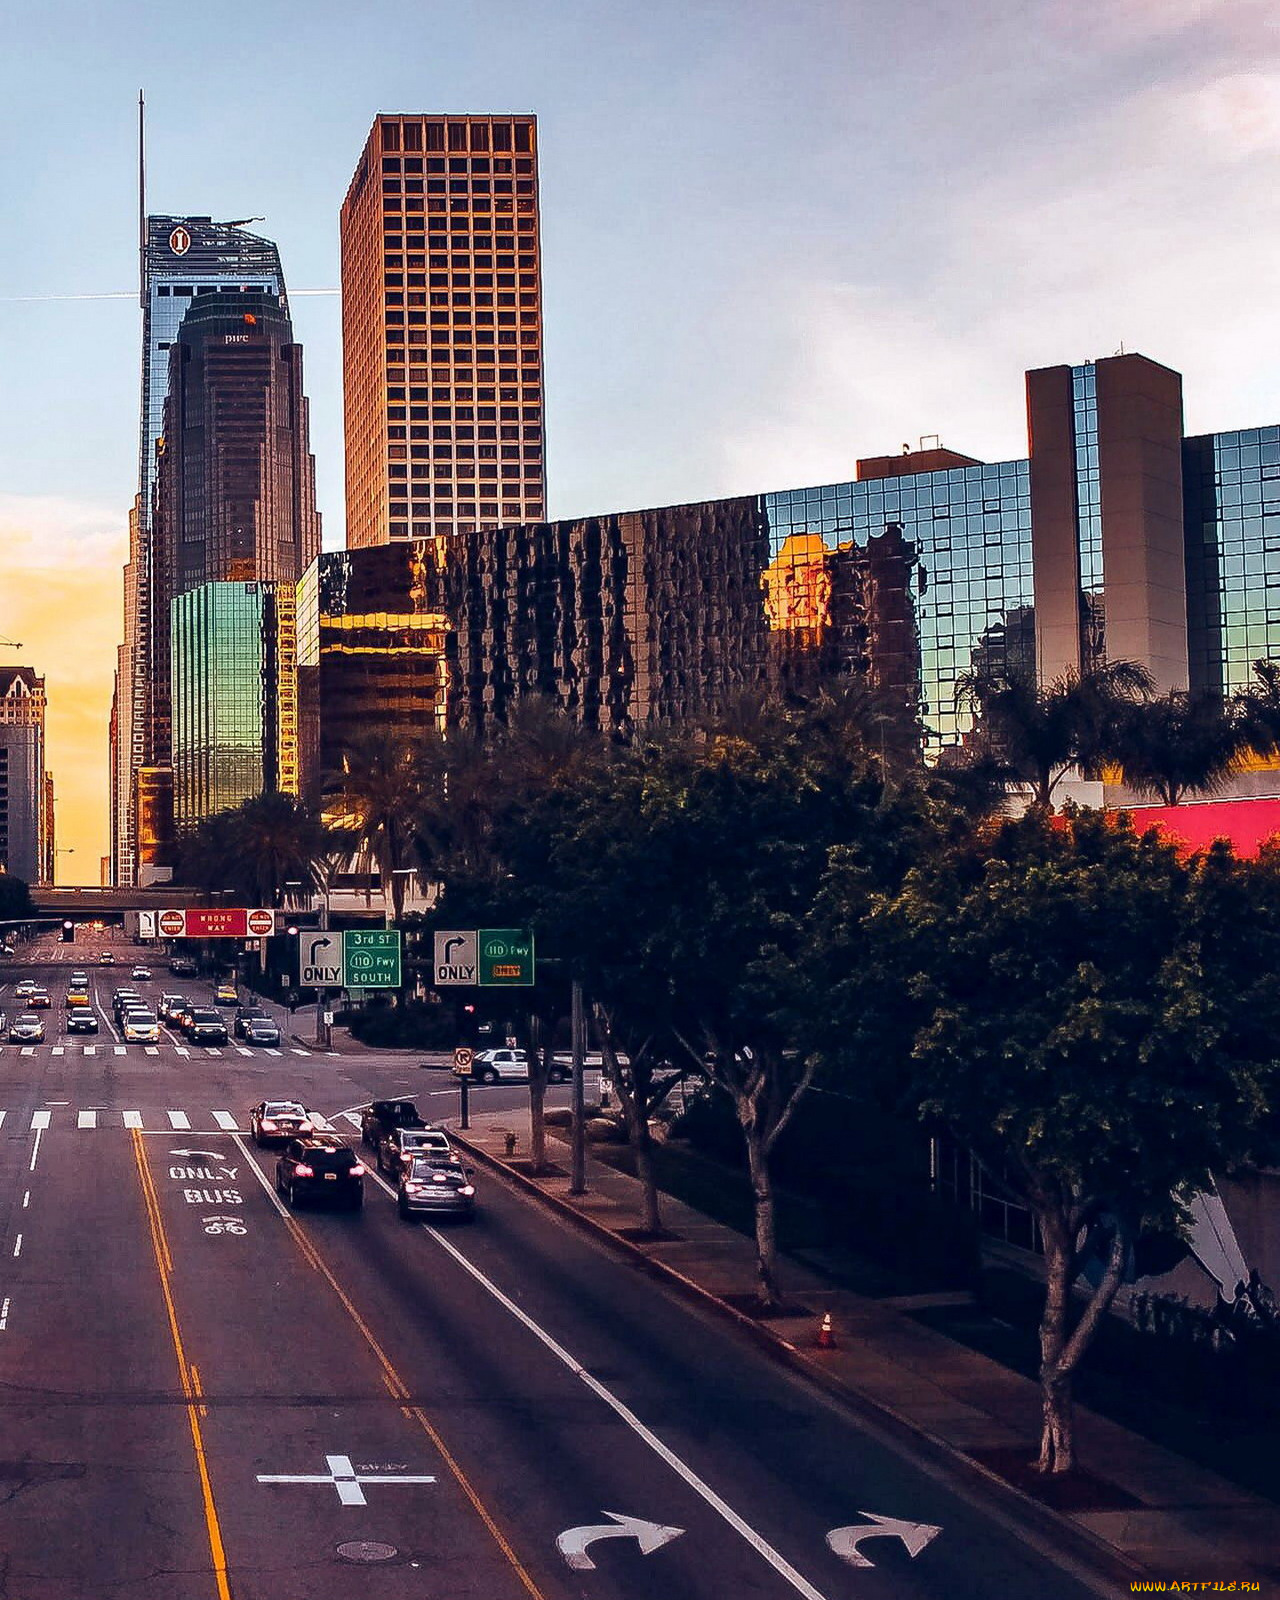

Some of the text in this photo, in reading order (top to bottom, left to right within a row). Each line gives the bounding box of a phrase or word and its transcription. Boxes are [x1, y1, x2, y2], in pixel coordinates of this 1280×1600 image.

[354, 934, 391, 945] 3rd ST
[489, 945, 504, 955] 110
[354, 956, 395, 968] 110 Fwy
[303, 967, 341, 981] ONLY
[353, 973, 391, 982] SOUTH
[438, 965, 475, 980] ONLY
[169, 1167, 238, 1180] ONLY
[183, 1189, 243, 1203] BUS
